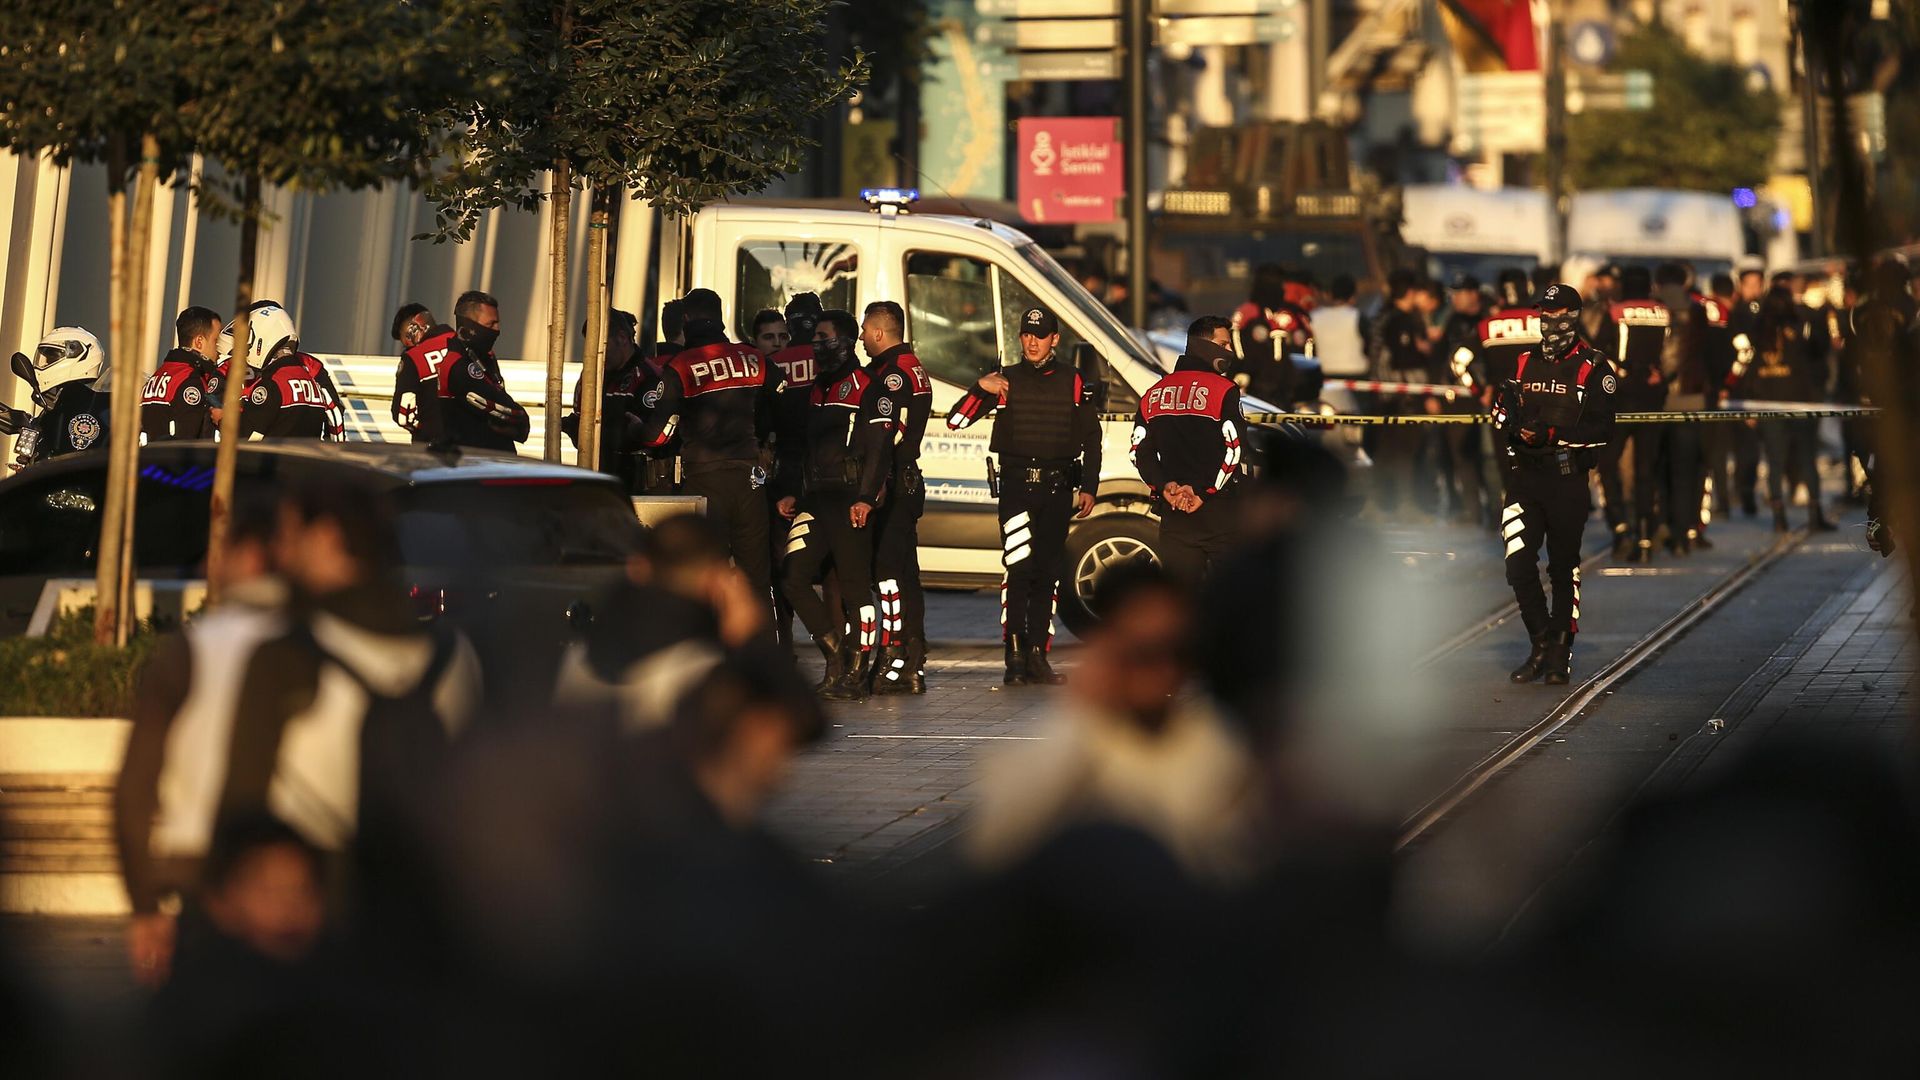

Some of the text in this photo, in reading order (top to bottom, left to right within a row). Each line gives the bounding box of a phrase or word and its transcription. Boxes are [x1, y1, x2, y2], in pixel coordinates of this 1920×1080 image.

[690, 351, 760, 387] POLİS
[1148, 381, 1209, 413] POLİS
[1523, 379, 1567, 394] POLİS
